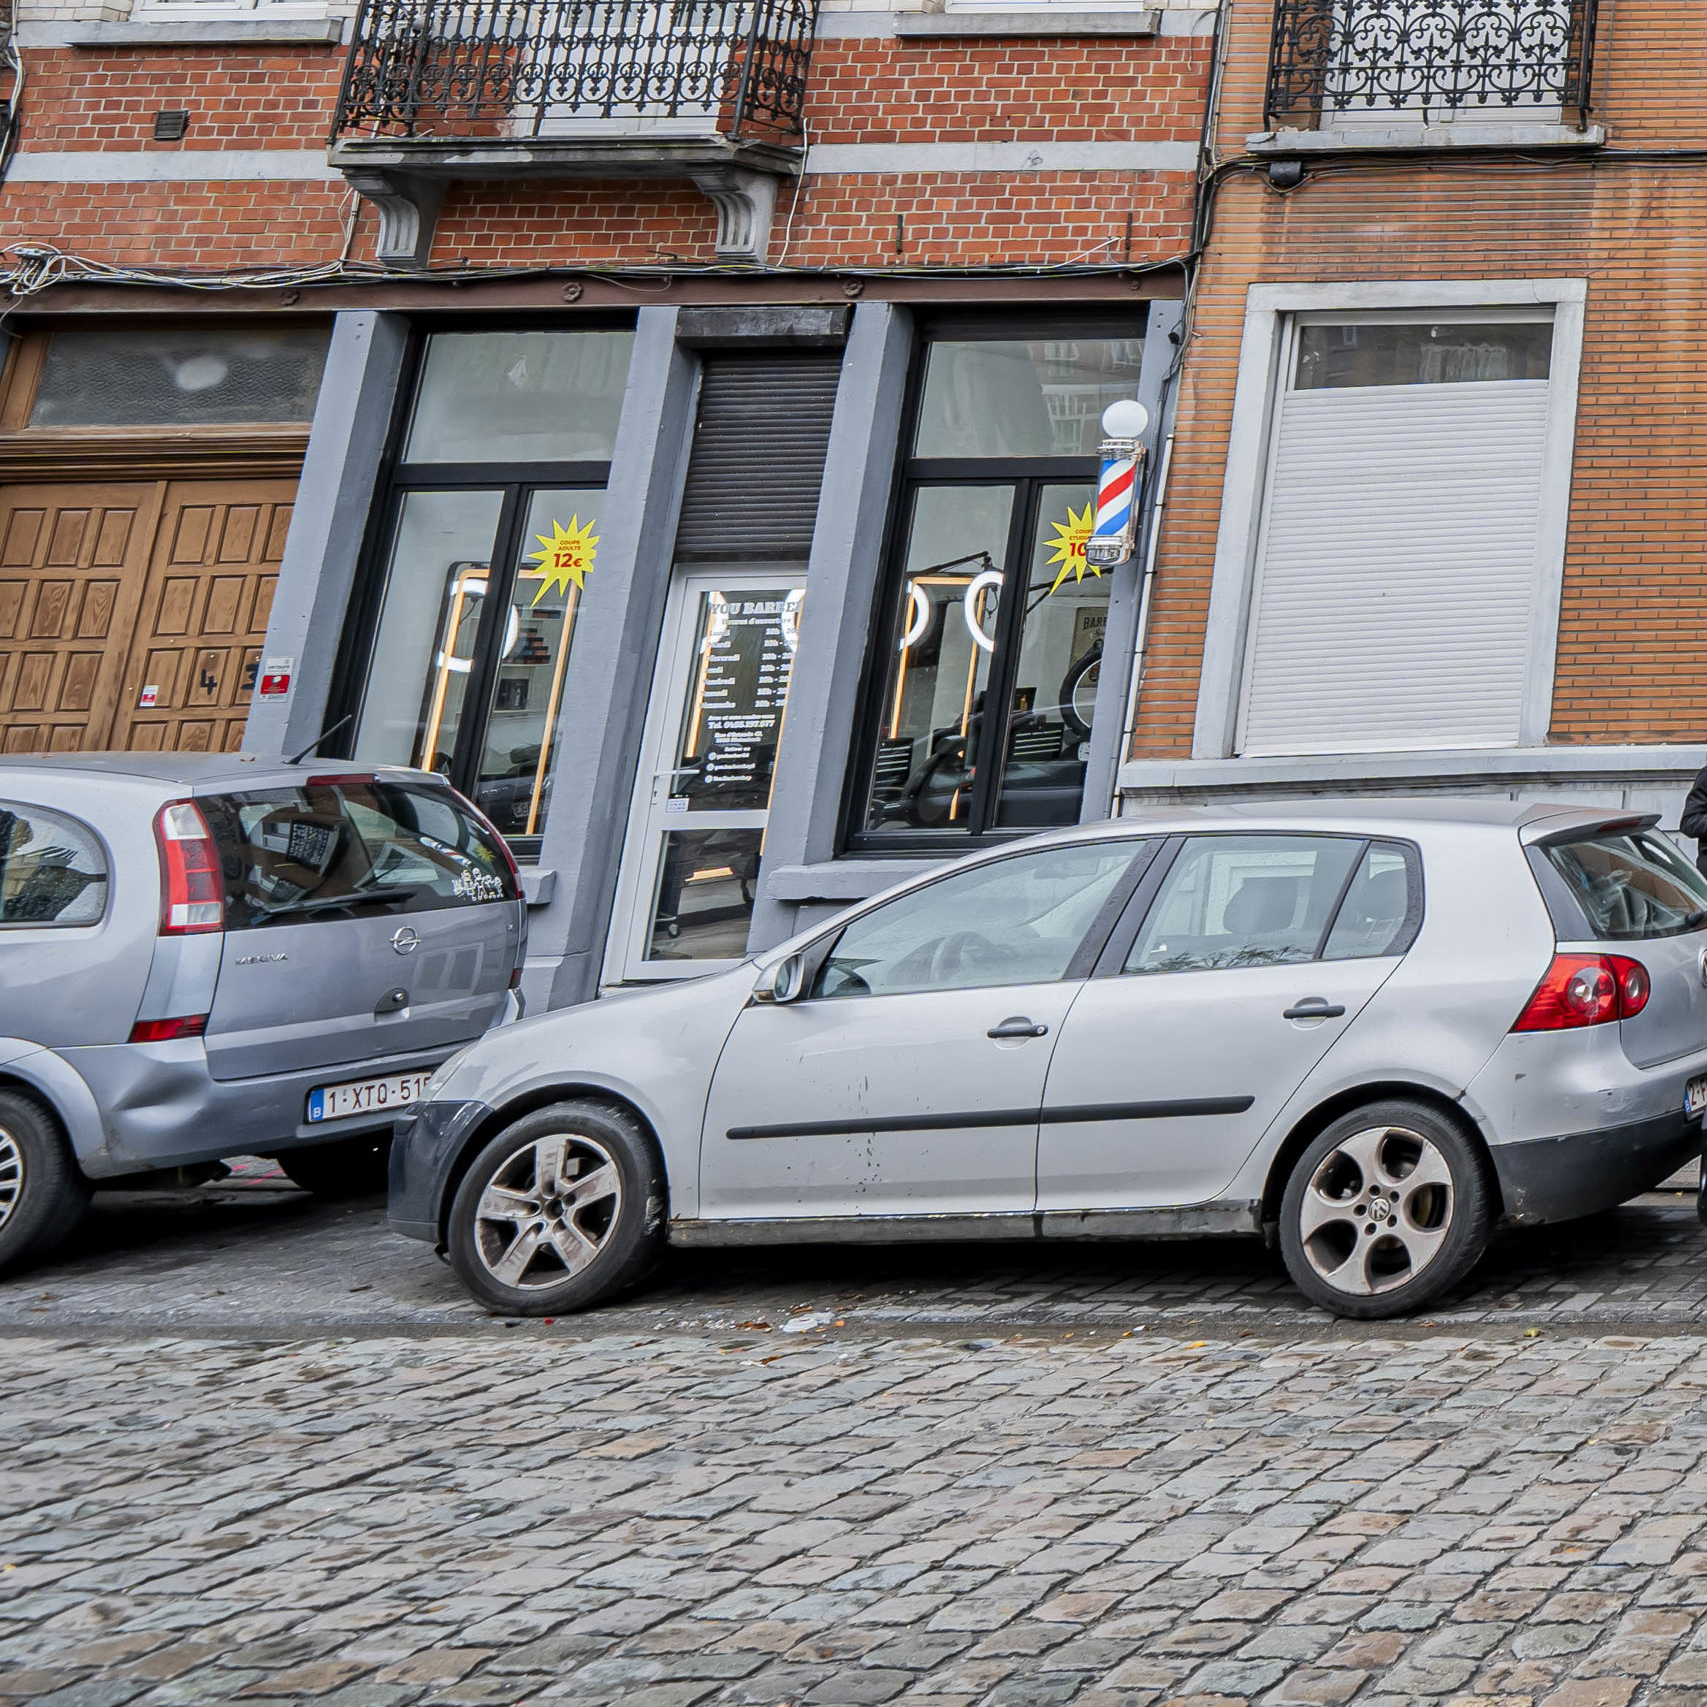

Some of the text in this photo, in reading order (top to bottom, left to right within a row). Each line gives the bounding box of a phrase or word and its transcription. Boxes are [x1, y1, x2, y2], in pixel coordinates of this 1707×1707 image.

[553, 552, 584, 568] 12€
[200, 669, 218, 696] 4
[313, 1106, 322, 1118] B
